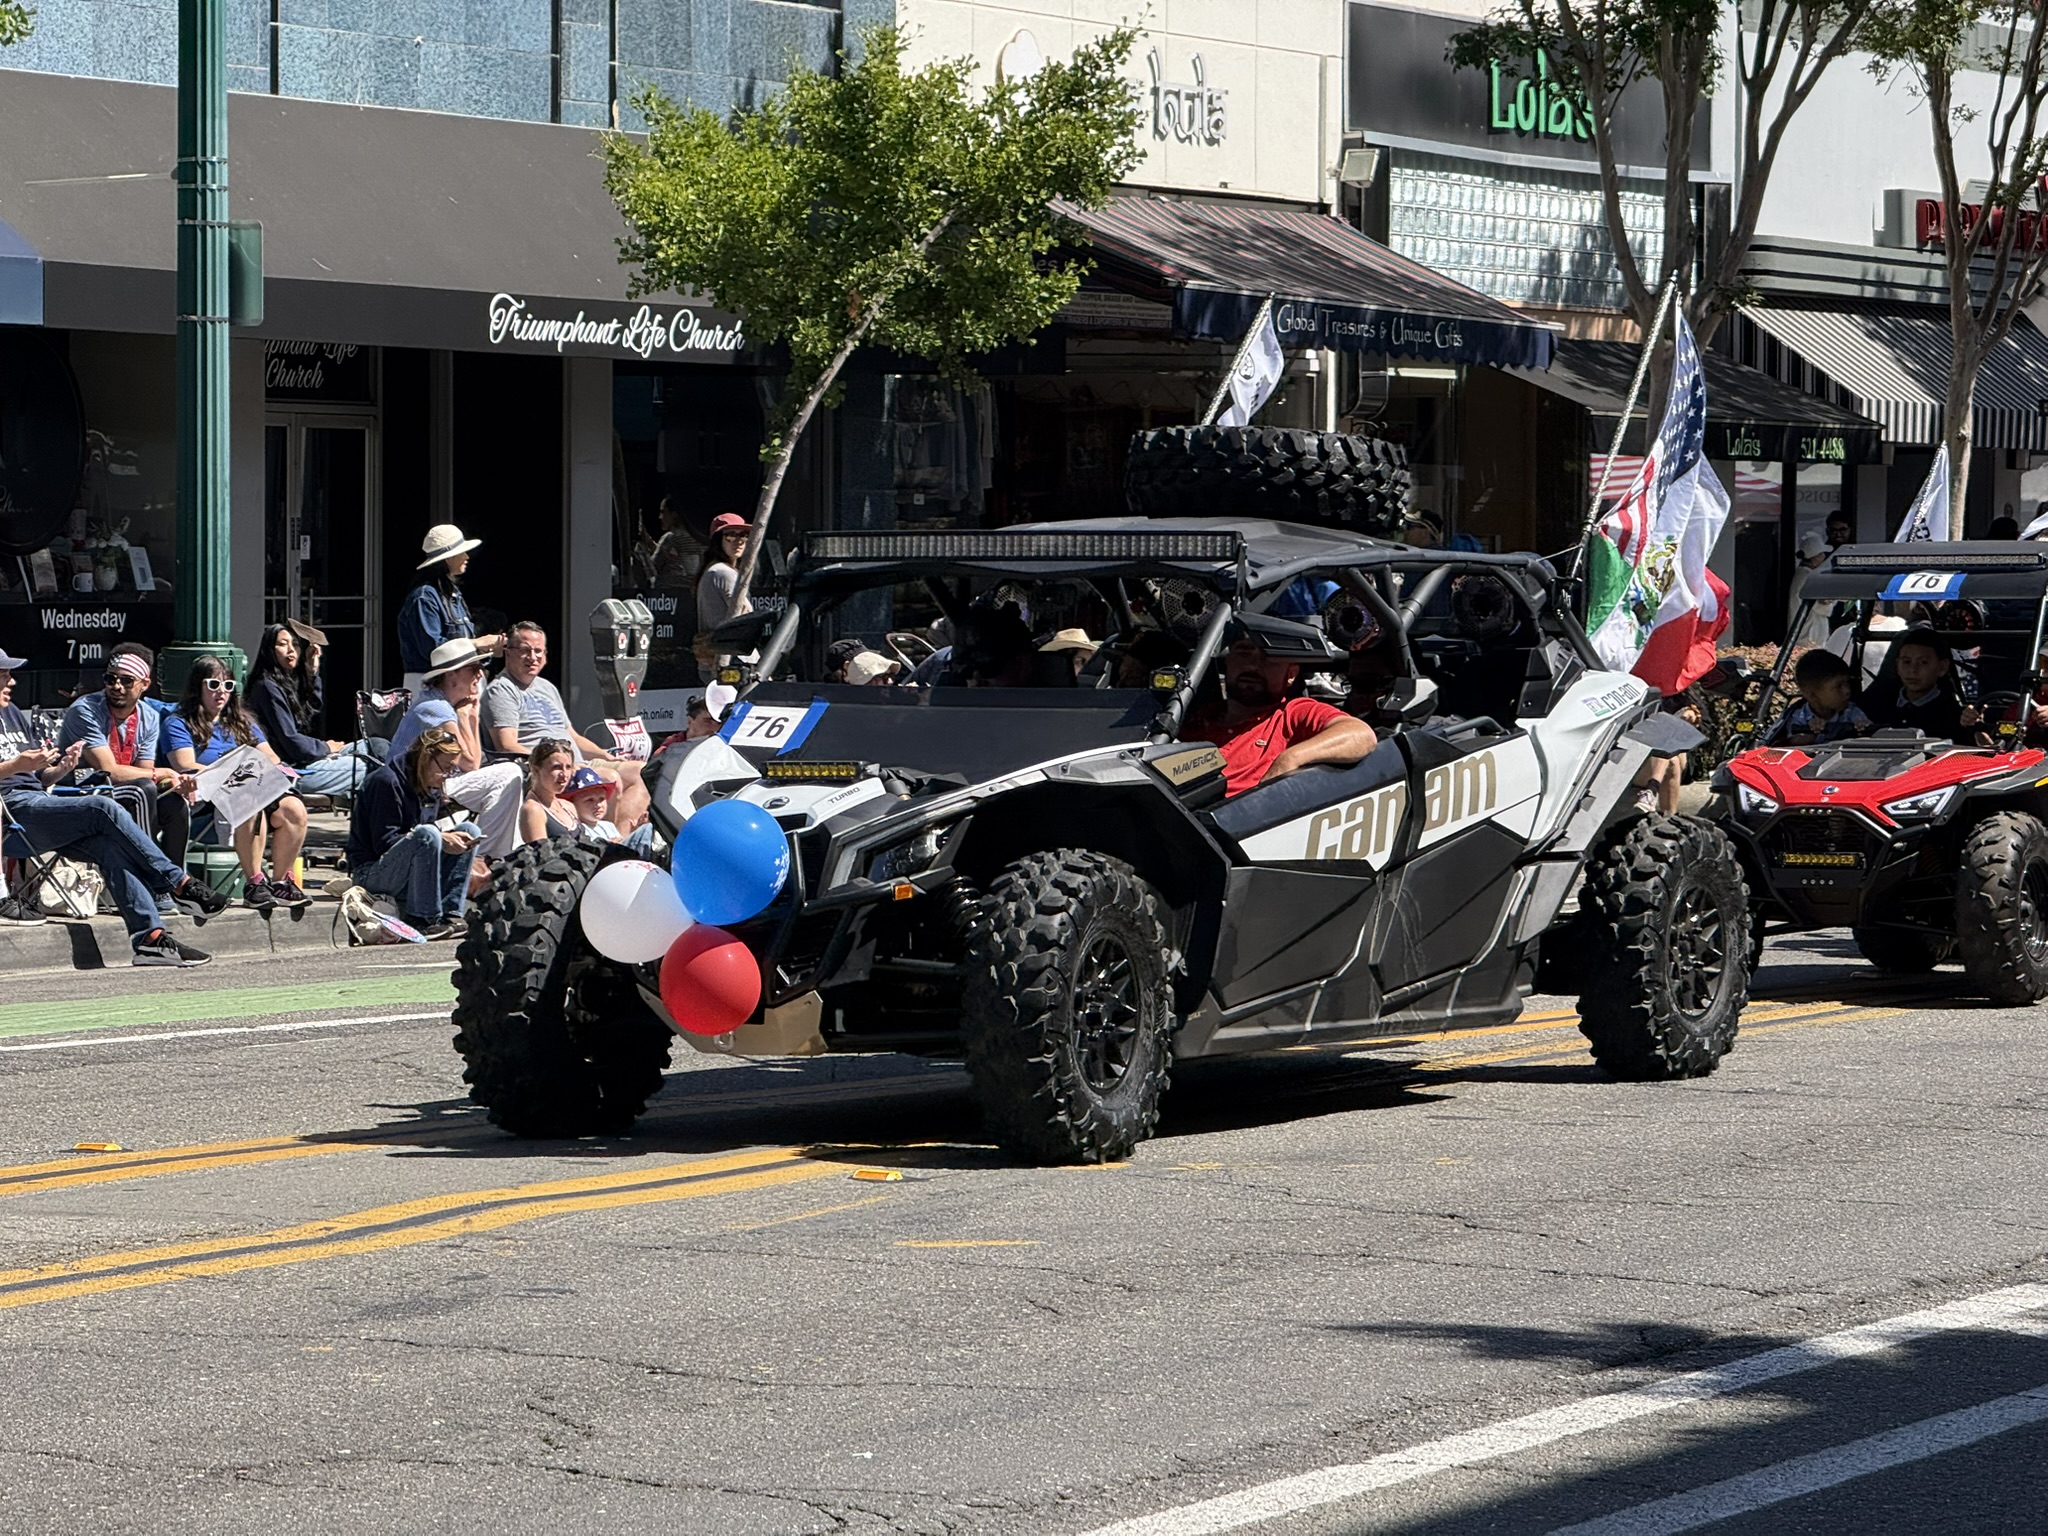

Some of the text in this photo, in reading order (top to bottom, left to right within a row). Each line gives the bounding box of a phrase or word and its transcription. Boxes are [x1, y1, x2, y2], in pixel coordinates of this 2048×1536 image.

[489, 293, 745, 359] Triumphant Life Church
[1277, 304, 1318, 333] Global
[1321, 308, 1376, 338] Treasures
[1391, 317, 1432, 352] Unique
[265, 358, 324, 388] Church
[1801, 437, 1845, 459] 521-4488
[1909, 574, 1941, 589] 76
[41, 608, 127, 632] Wednesday
[656, 624, 673, 638] am
[67, 640, 102, 664] 7 pm
[746, 716, 789, 739] 76
[1172, 749, 1218, 777] MAVERICK
[827, 786, 861, 804] TURBO
